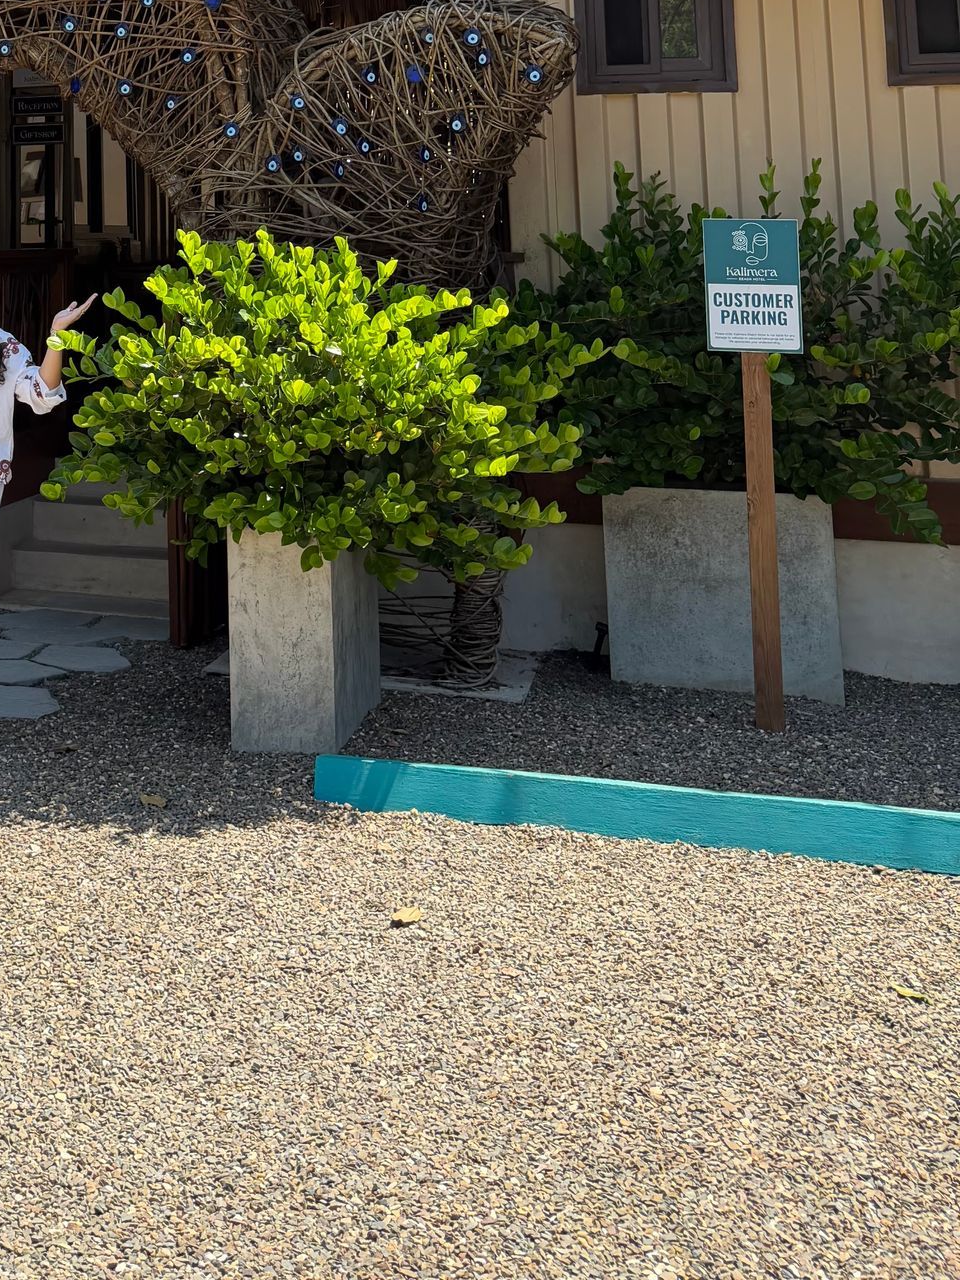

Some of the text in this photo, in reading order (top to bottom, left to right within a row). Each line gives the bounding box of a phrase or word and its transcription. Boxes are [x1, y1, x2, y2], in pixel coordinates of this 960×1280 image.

[17, 101, 59, 111] RECEPTION
[726, 266, 778, 277] Kalimera
[713, 292, 794, 309] CUSTOMER
[720, 310, 788, 326] PARKING
